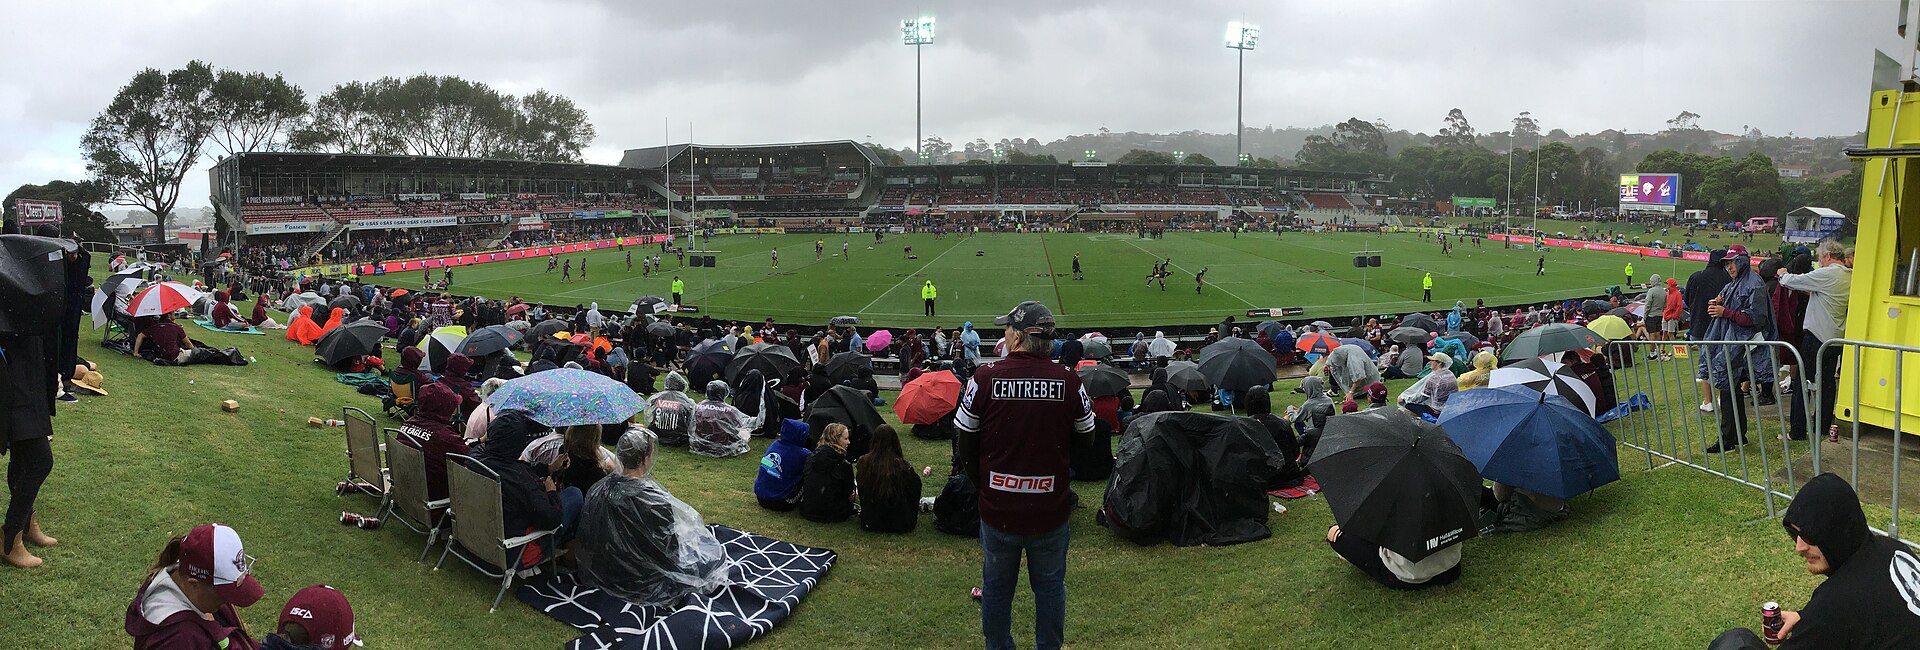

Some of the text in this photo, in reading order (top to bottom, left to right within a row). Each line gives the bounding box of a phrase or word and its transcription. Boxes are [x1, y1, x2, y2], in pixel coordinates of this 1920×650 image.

[25, 203, 56, 220] Cheers Manly
[993, 380, 1064, 398] CENTREBET
[657, 400, 678, 409] VANS
[407, 428, 432, 441] EAGLES
[992, 474, 1053, 491] SONIQ
[290, 607, 312, 618] ISCA
